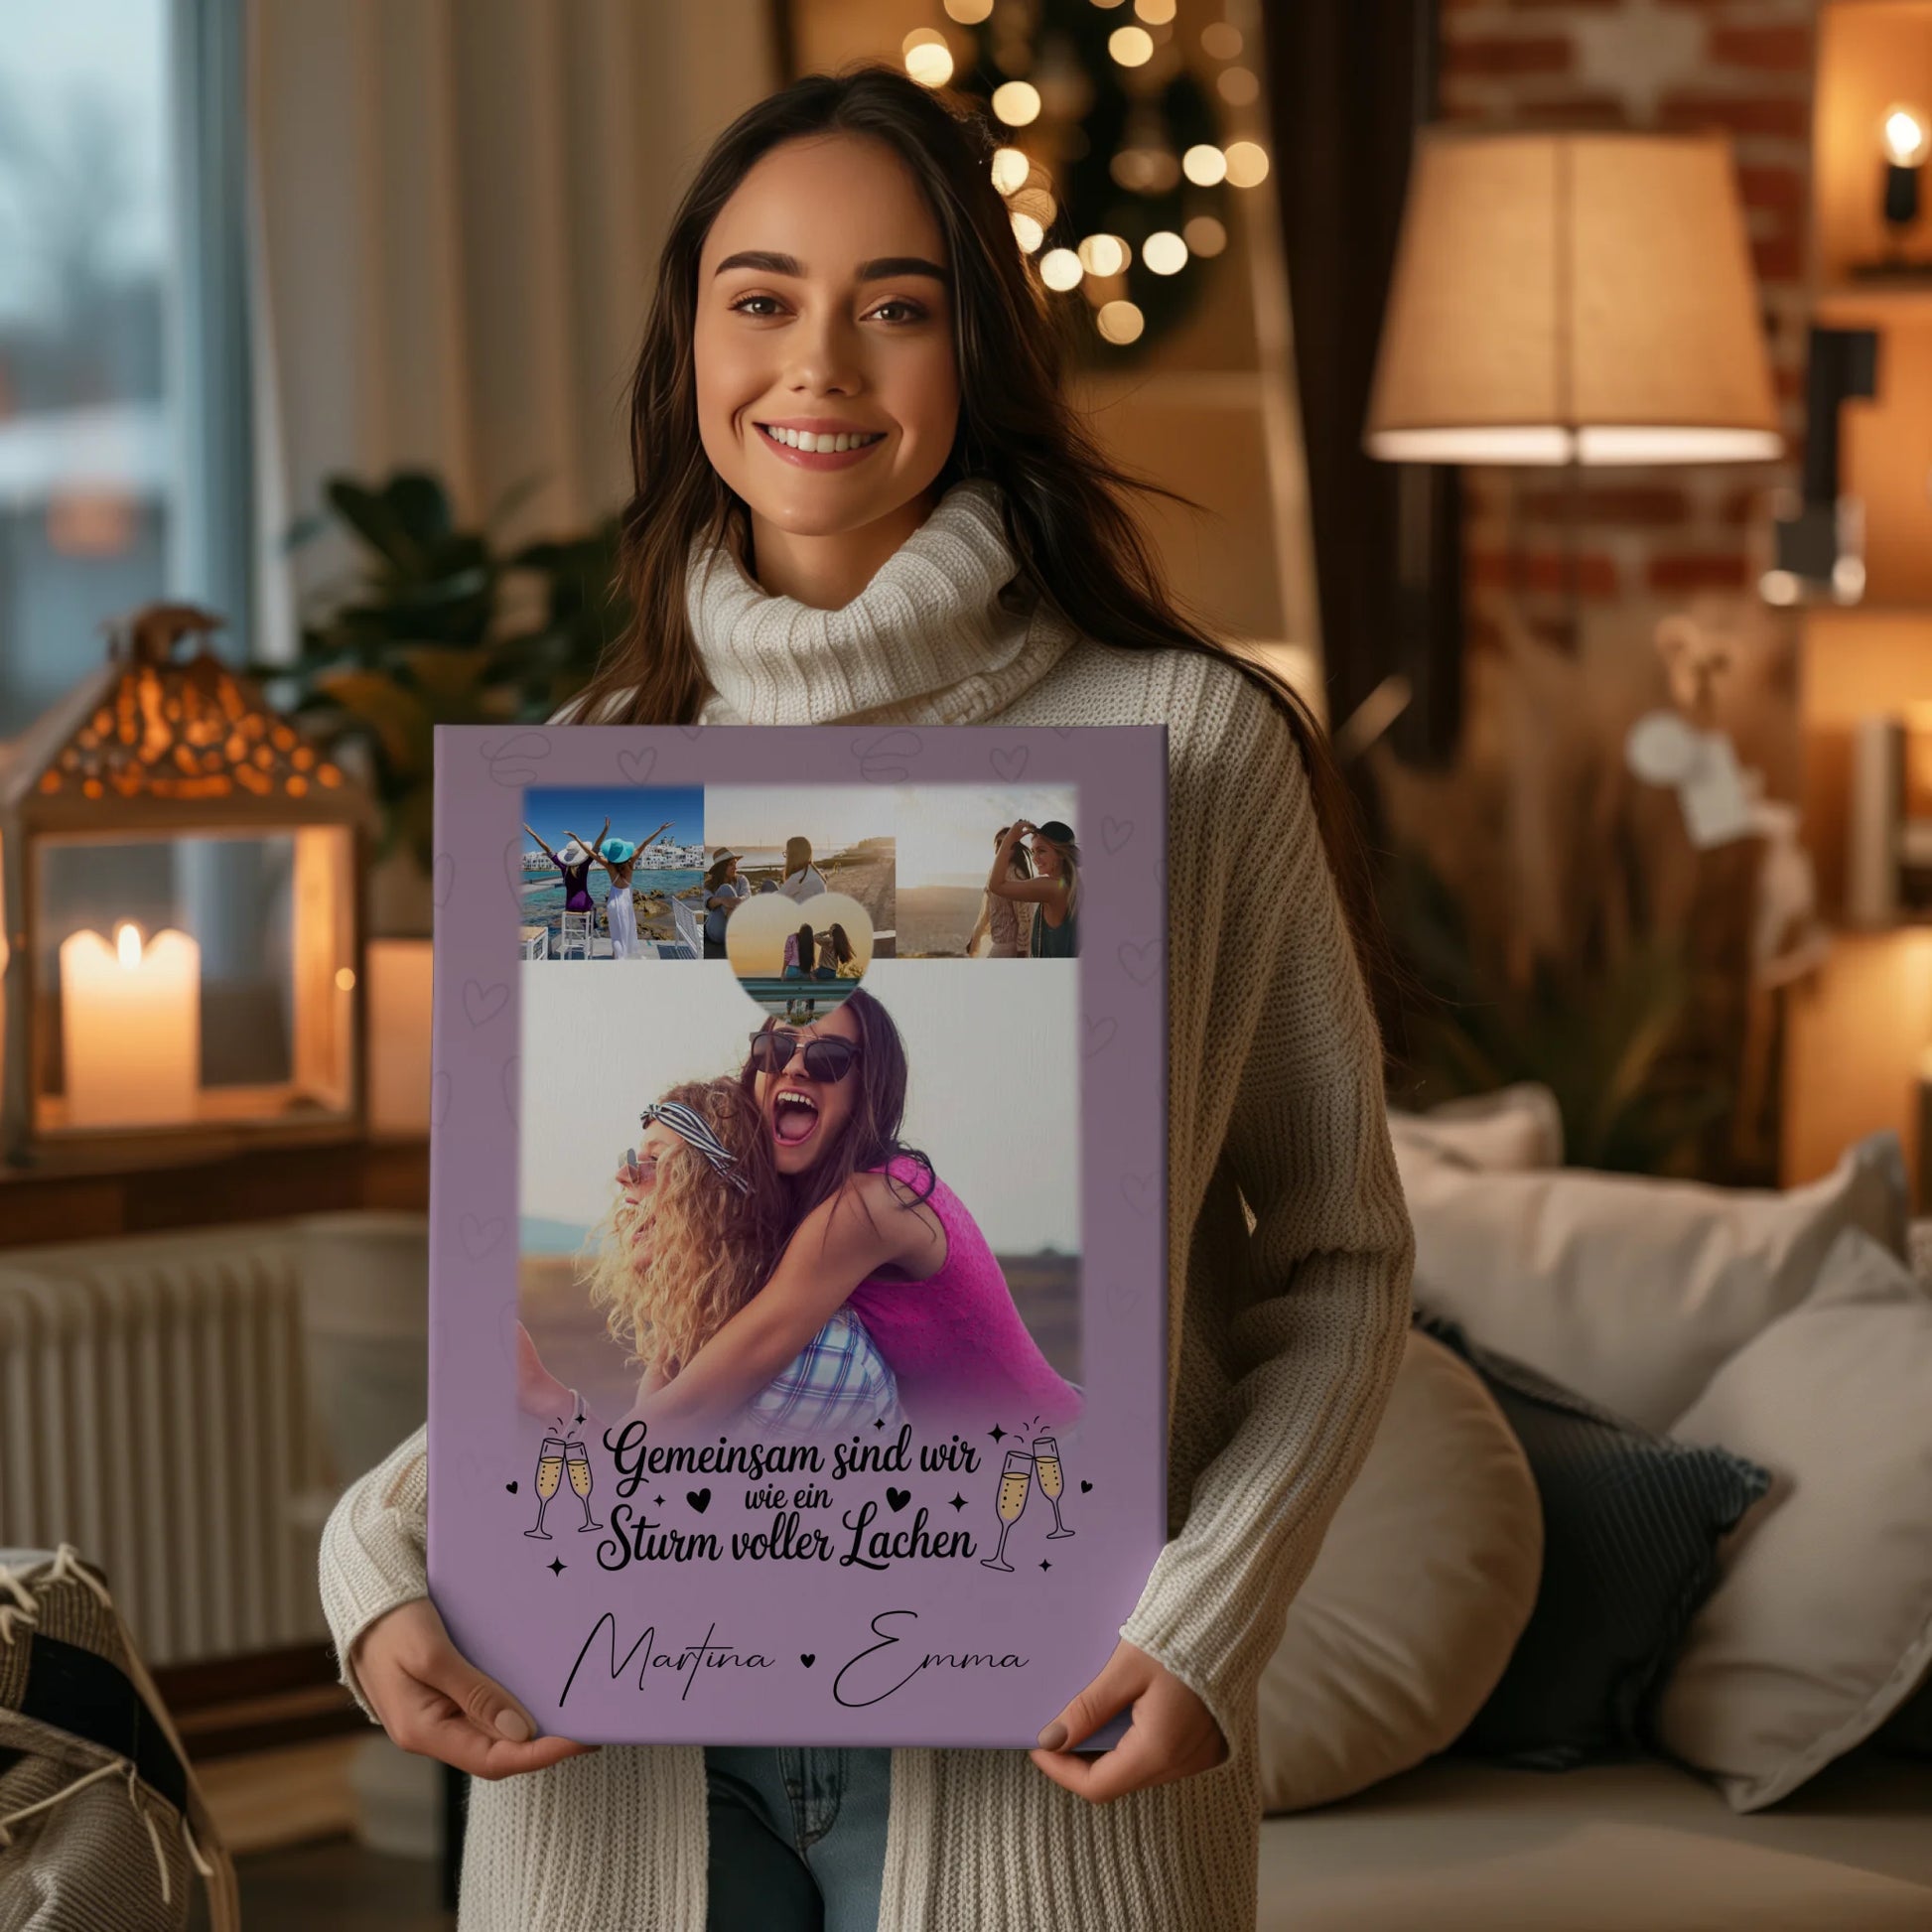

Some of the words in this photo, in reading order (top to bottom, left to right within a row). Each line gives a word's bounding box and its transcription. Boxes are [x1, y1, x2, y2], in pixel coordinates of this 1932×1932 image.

[602, 1420, 826, 1499] Gemeinsam
[831, 1423, 912, 1481] sind
[919, 1434, 982, 1474] wir
[744, 1482, 789, 1510] wie
[792, 1482, 834, 1509] ein
[596, 1503, 725, 1572] Sturm
[731, 1510, 835, 1562] voller
[838, 1500, 978, 1571] Lachen
[558, 1611, 775, 1708] Martina
[832, 1609, 1031, 1708] Emma
